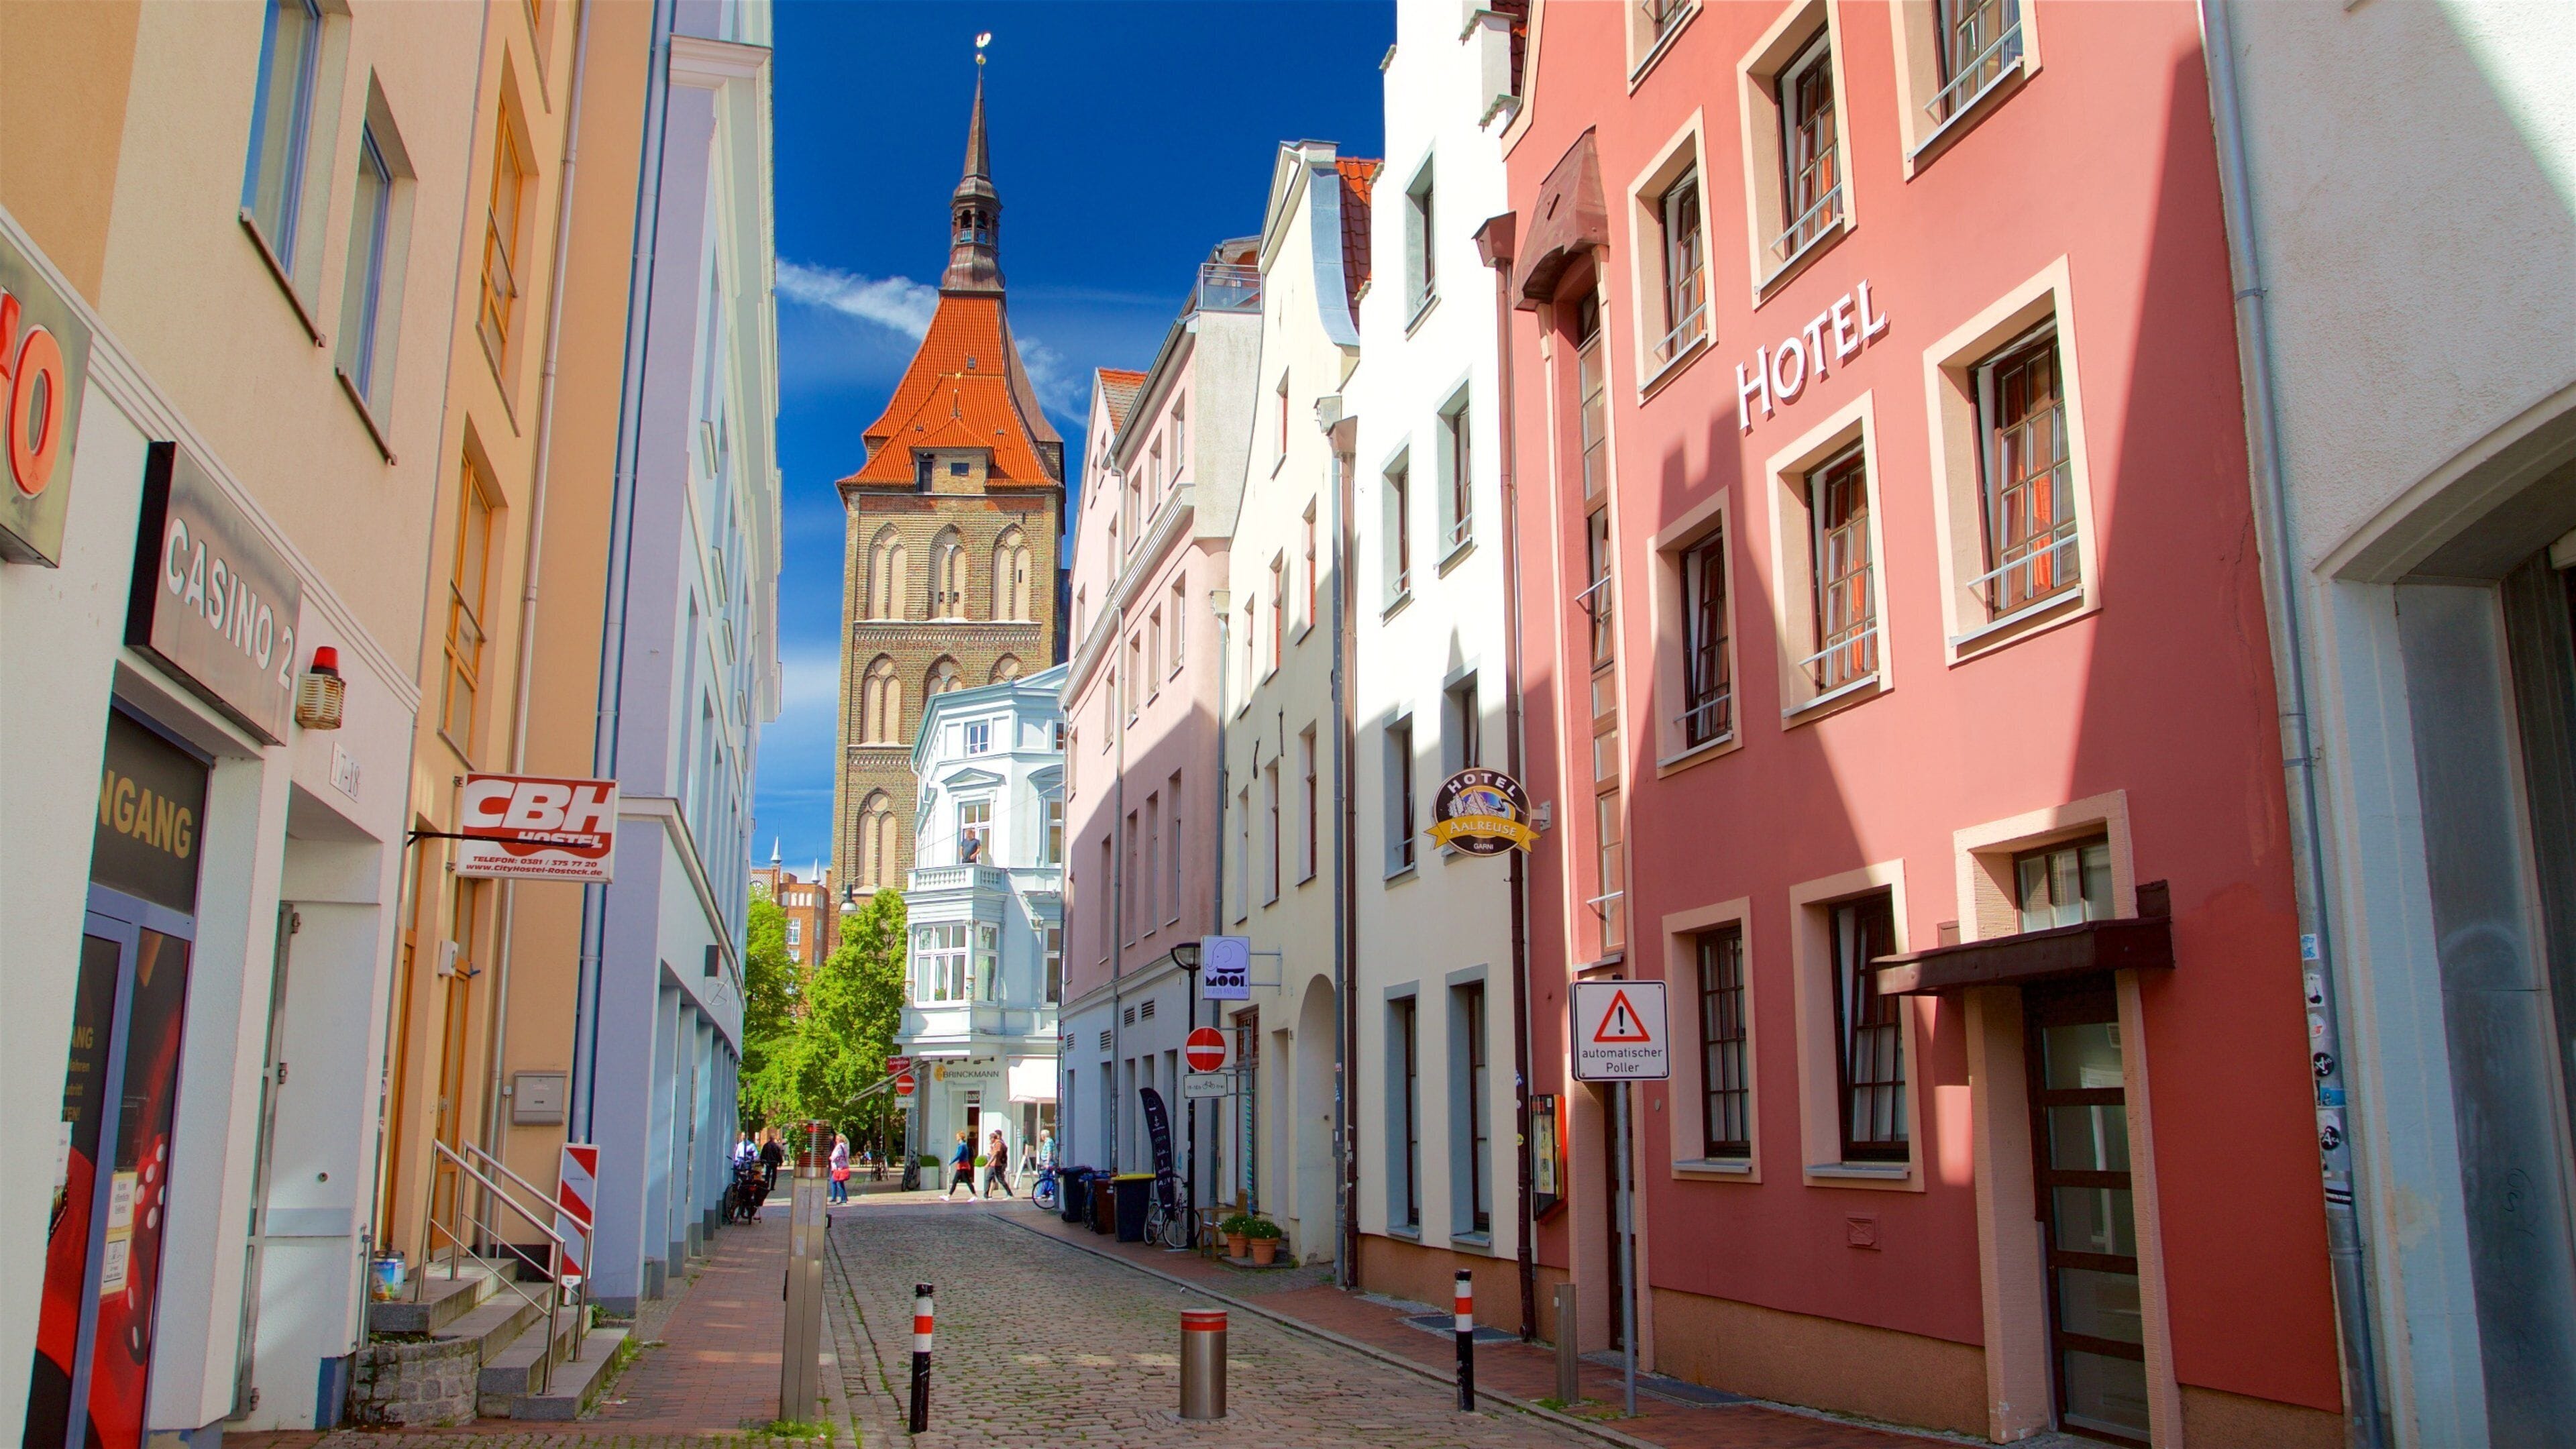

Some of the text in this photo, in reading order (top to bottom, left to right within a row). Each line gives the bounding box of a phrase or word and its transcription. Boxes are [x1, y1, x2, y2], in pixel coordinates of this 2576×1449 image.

[1735, 278, 1887, 431] HOTEL
[166, 517, 295, 692] CASINO 2
[1447, 773, 1517, 798] HOTEL
[463, 779, 615, 834] CBH
[515, 830, 603, 849] HOSTEL
[473, 855, 519, 865] TELEFON:
[466, 863, 603, 877] www.CityHostel-Rostock.de
[1582, 1047, 1663, 1059] automatischer
[1606, 1062, 1640, 1073] Poller
